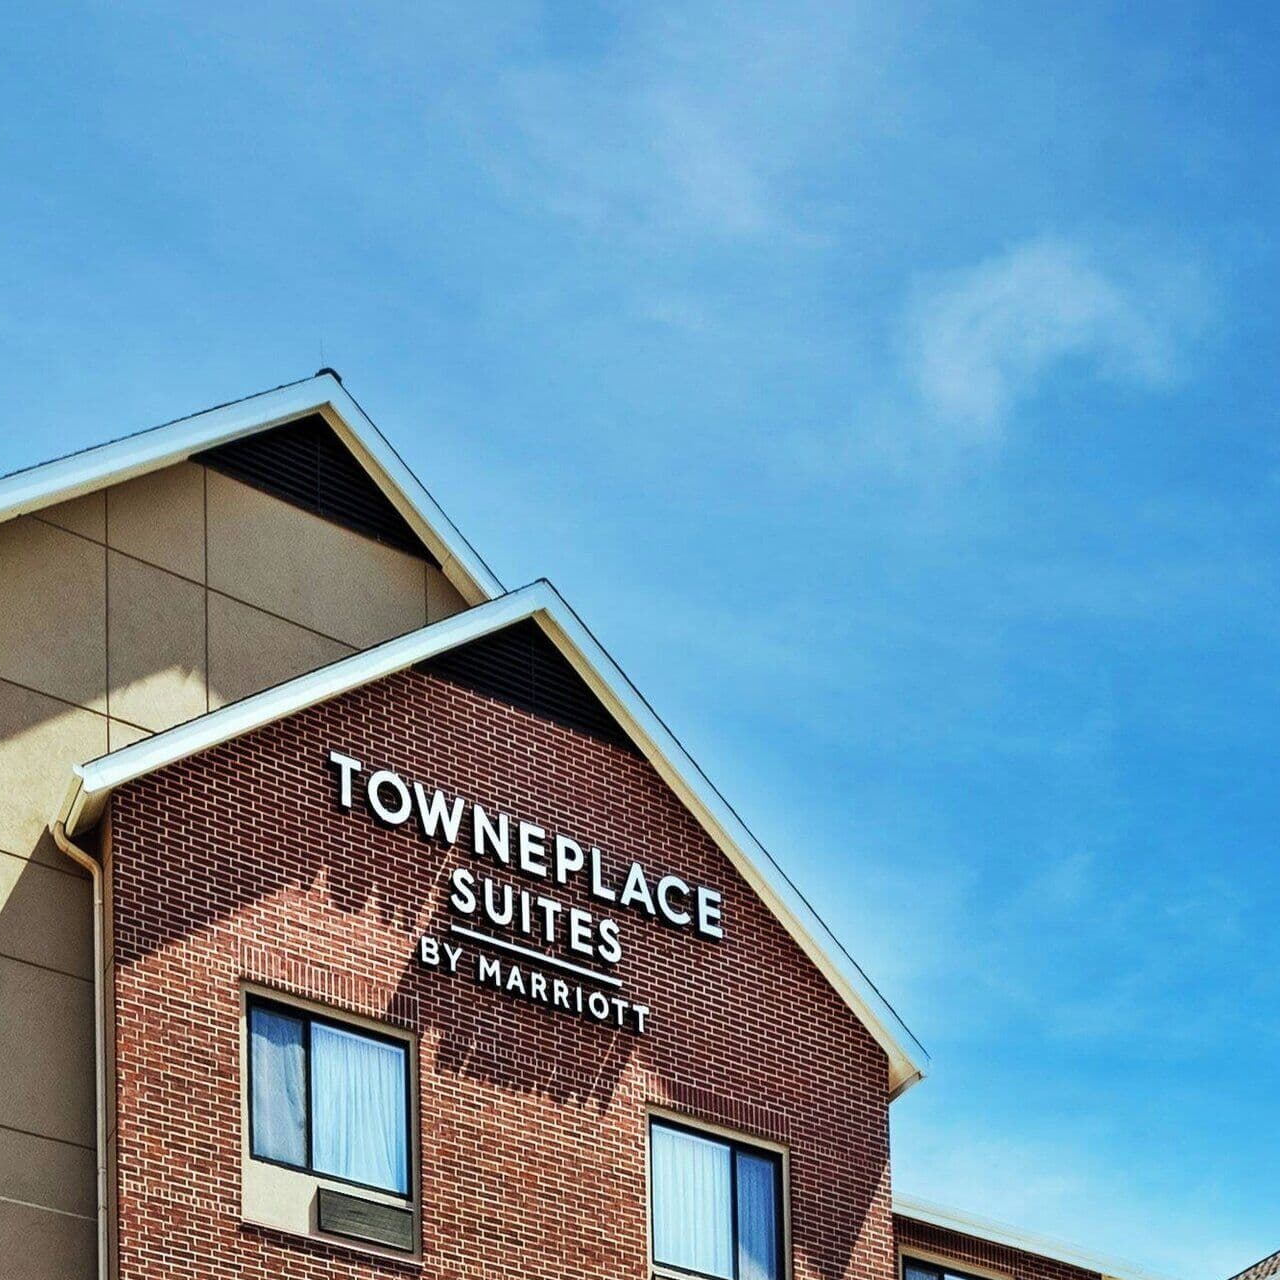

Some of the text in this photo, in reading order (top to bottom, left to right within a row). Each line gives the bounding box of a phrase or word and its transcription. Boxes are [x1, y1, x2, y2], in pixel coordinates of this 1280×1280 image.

[330, 751, 724, 938] TOWNEPLACE
[451, 868, 623, 963] SUITES
[421, 935, 650, 1033] BY MARRIOTT
